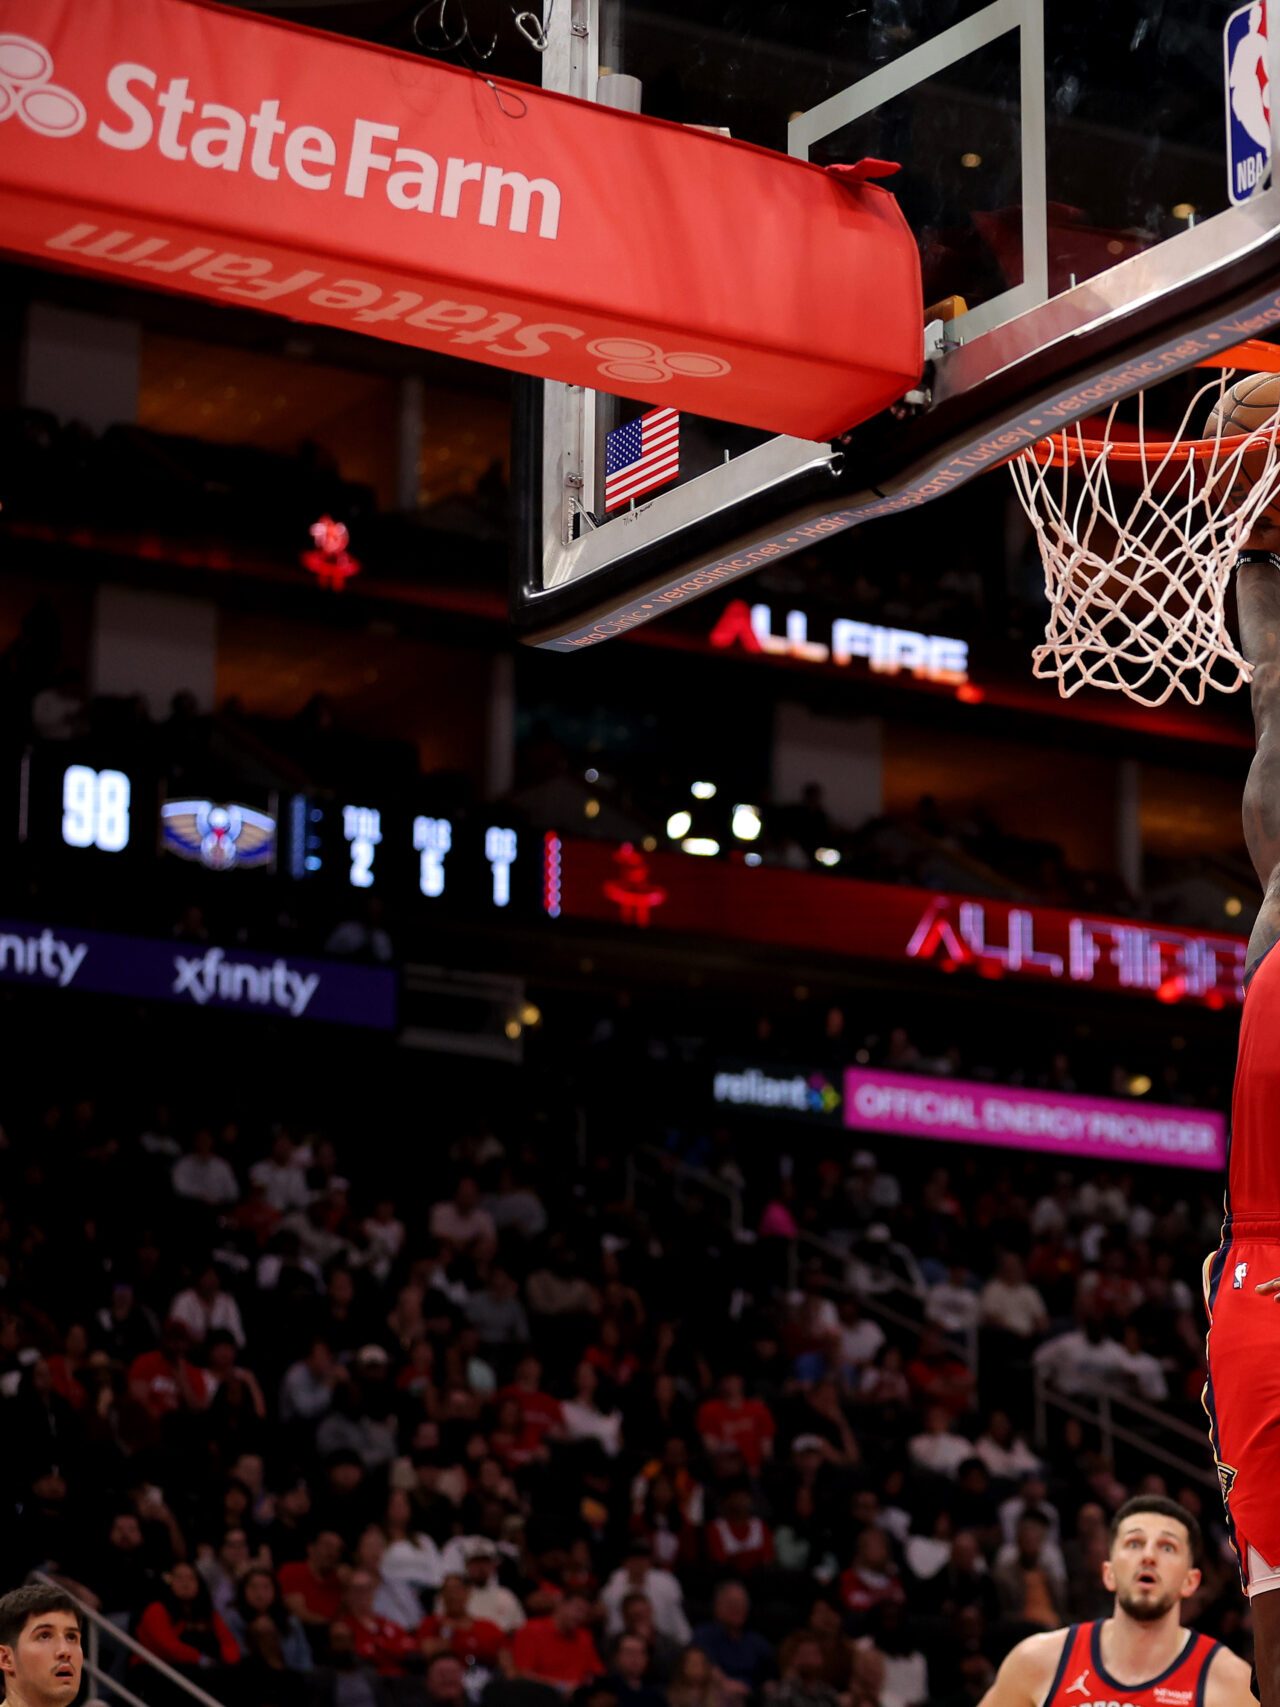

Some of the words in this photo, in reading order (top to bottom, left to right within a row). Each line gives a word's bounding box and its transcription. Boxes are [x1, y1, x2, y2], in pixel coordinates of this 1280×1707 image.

[1236, 151, 1264, 194] NBA
[652, 542, 790, 604] veraclinic.net
[796, 514, 849, 538] Hair
[949, 426, 1037, 470] Turkey
[1043, 337, 1211, 417] veraclinic.net
[709, 598, 829, 663] ALL
[831, 617, 969, 686] FIRE
[62, 765, 131, 852] 98
[172, 946, 320, 1018] xfinity
[713, 1069, 809, 1111] reliant
[854, 1083, 979, 1129] OFFICIAL
[982, 1099, 1086, 1140] ENERGY
[1088, 1111, 1217, 1155] PROVIDER
